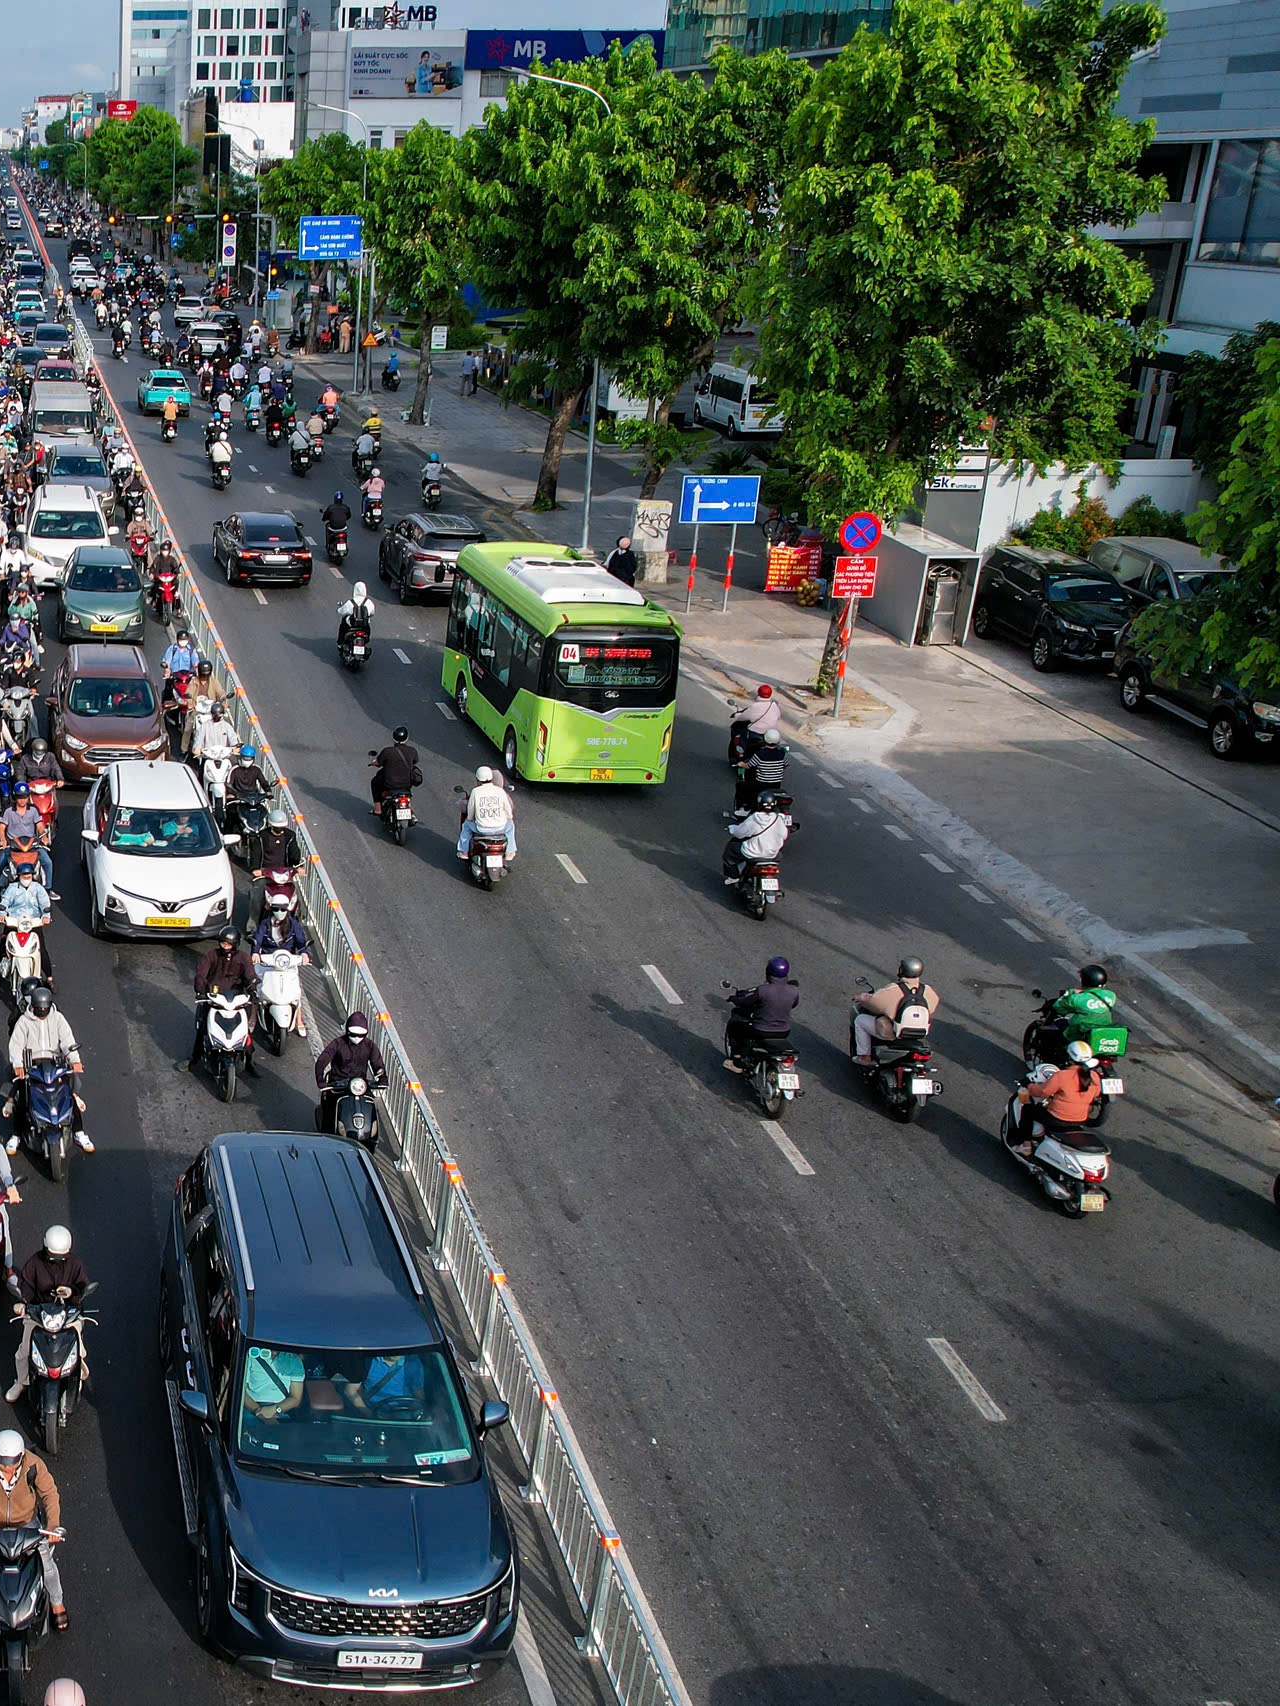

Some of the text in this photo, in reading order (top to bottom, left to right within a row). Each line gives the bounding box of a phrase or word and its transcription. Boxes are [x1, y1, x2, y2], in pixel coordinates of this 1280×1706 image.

[408, 6, 437, 21] MB
[513, 40, 546, 57] MB
[933, 477, 949, 488] sk
[562, 647, 576, 659] 04
[368, 1588, 398, 1597] KIA
[345, 1655, 416, 1665] 51A-347.77
